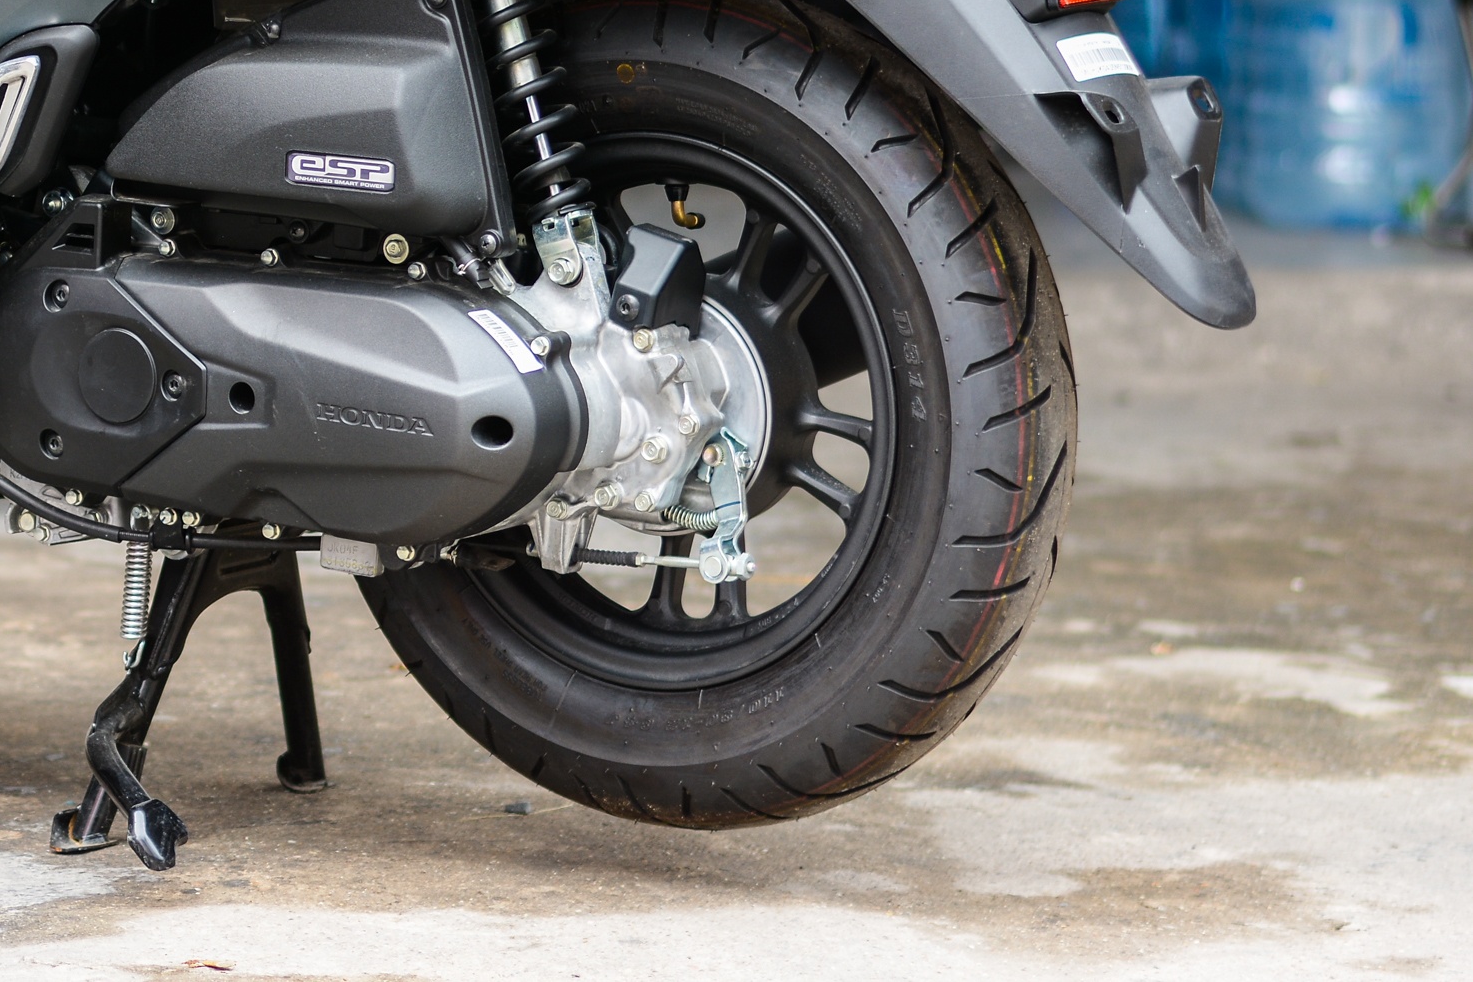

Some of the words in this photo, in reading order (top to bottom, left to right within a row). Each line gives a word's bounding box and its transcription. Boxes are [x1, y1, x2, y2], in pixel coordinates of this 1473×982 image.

[294, 175, 333, 185] ENHANCED
[334, 179, 359, 187] SMART
[316, 402, 434, 437] HONDA
